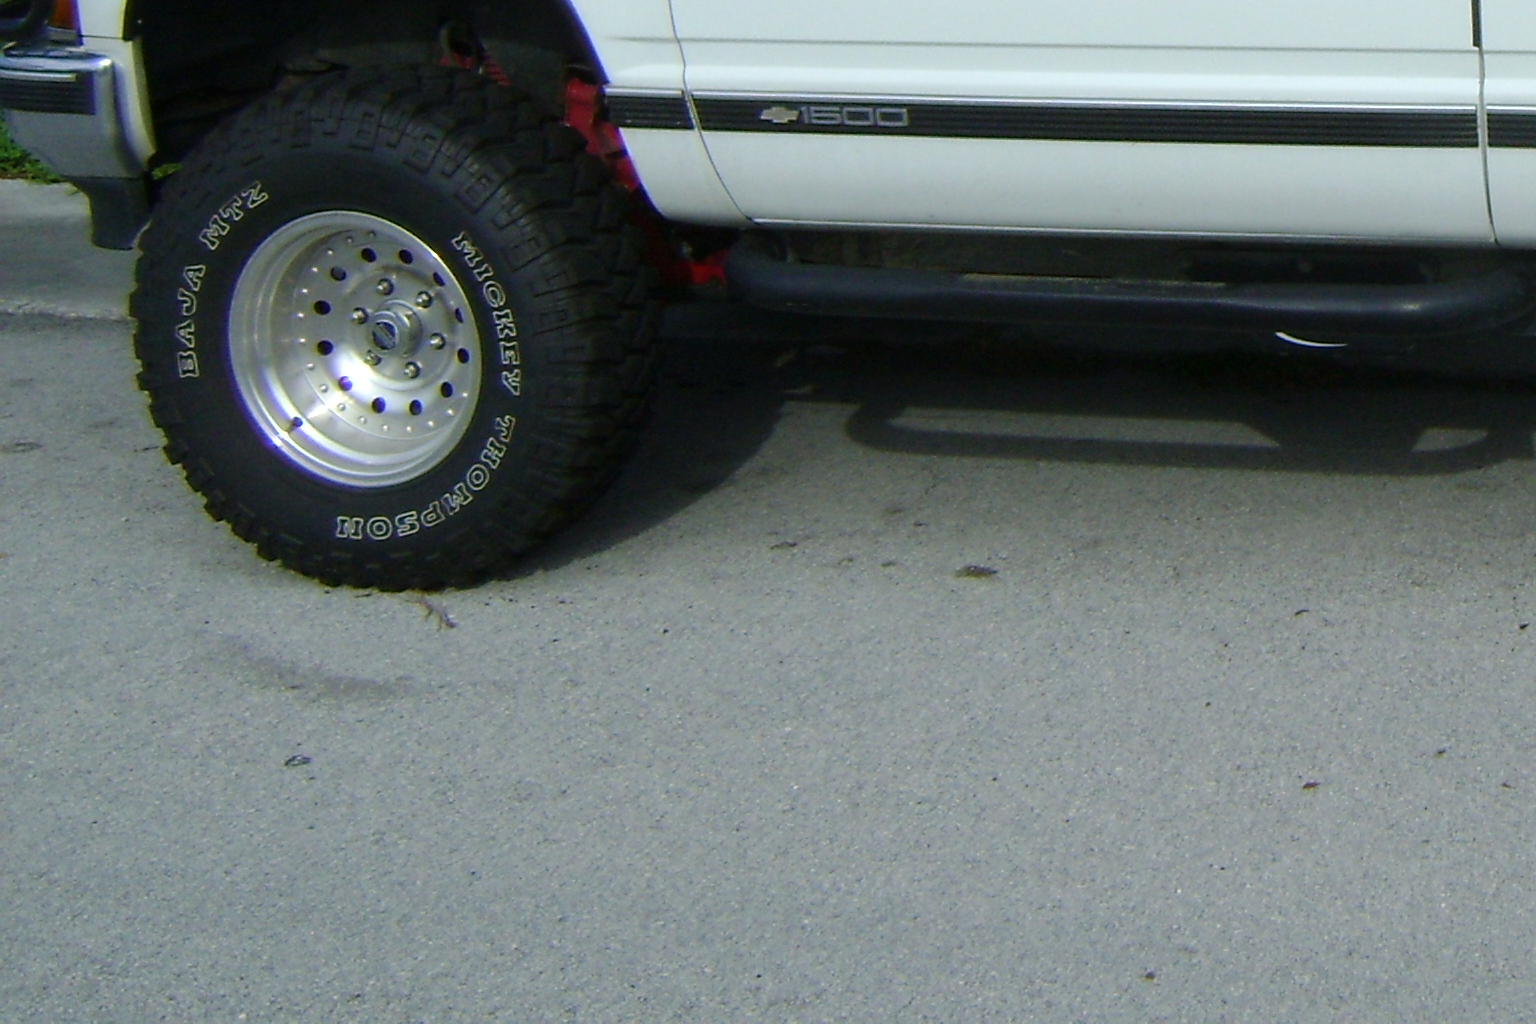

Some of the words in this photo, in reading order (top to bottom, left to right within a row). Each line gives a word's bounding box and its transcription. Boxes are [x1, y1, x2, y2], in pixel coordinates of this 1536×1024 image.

[801, 105, 909, 127] 1500
[176, 263, 206, 378] BAJA
[199, 181, 269, 250] MTZ
[452, 231, 521, 395] MICKEY
[336, 414, 516, 540] THOMPSON
